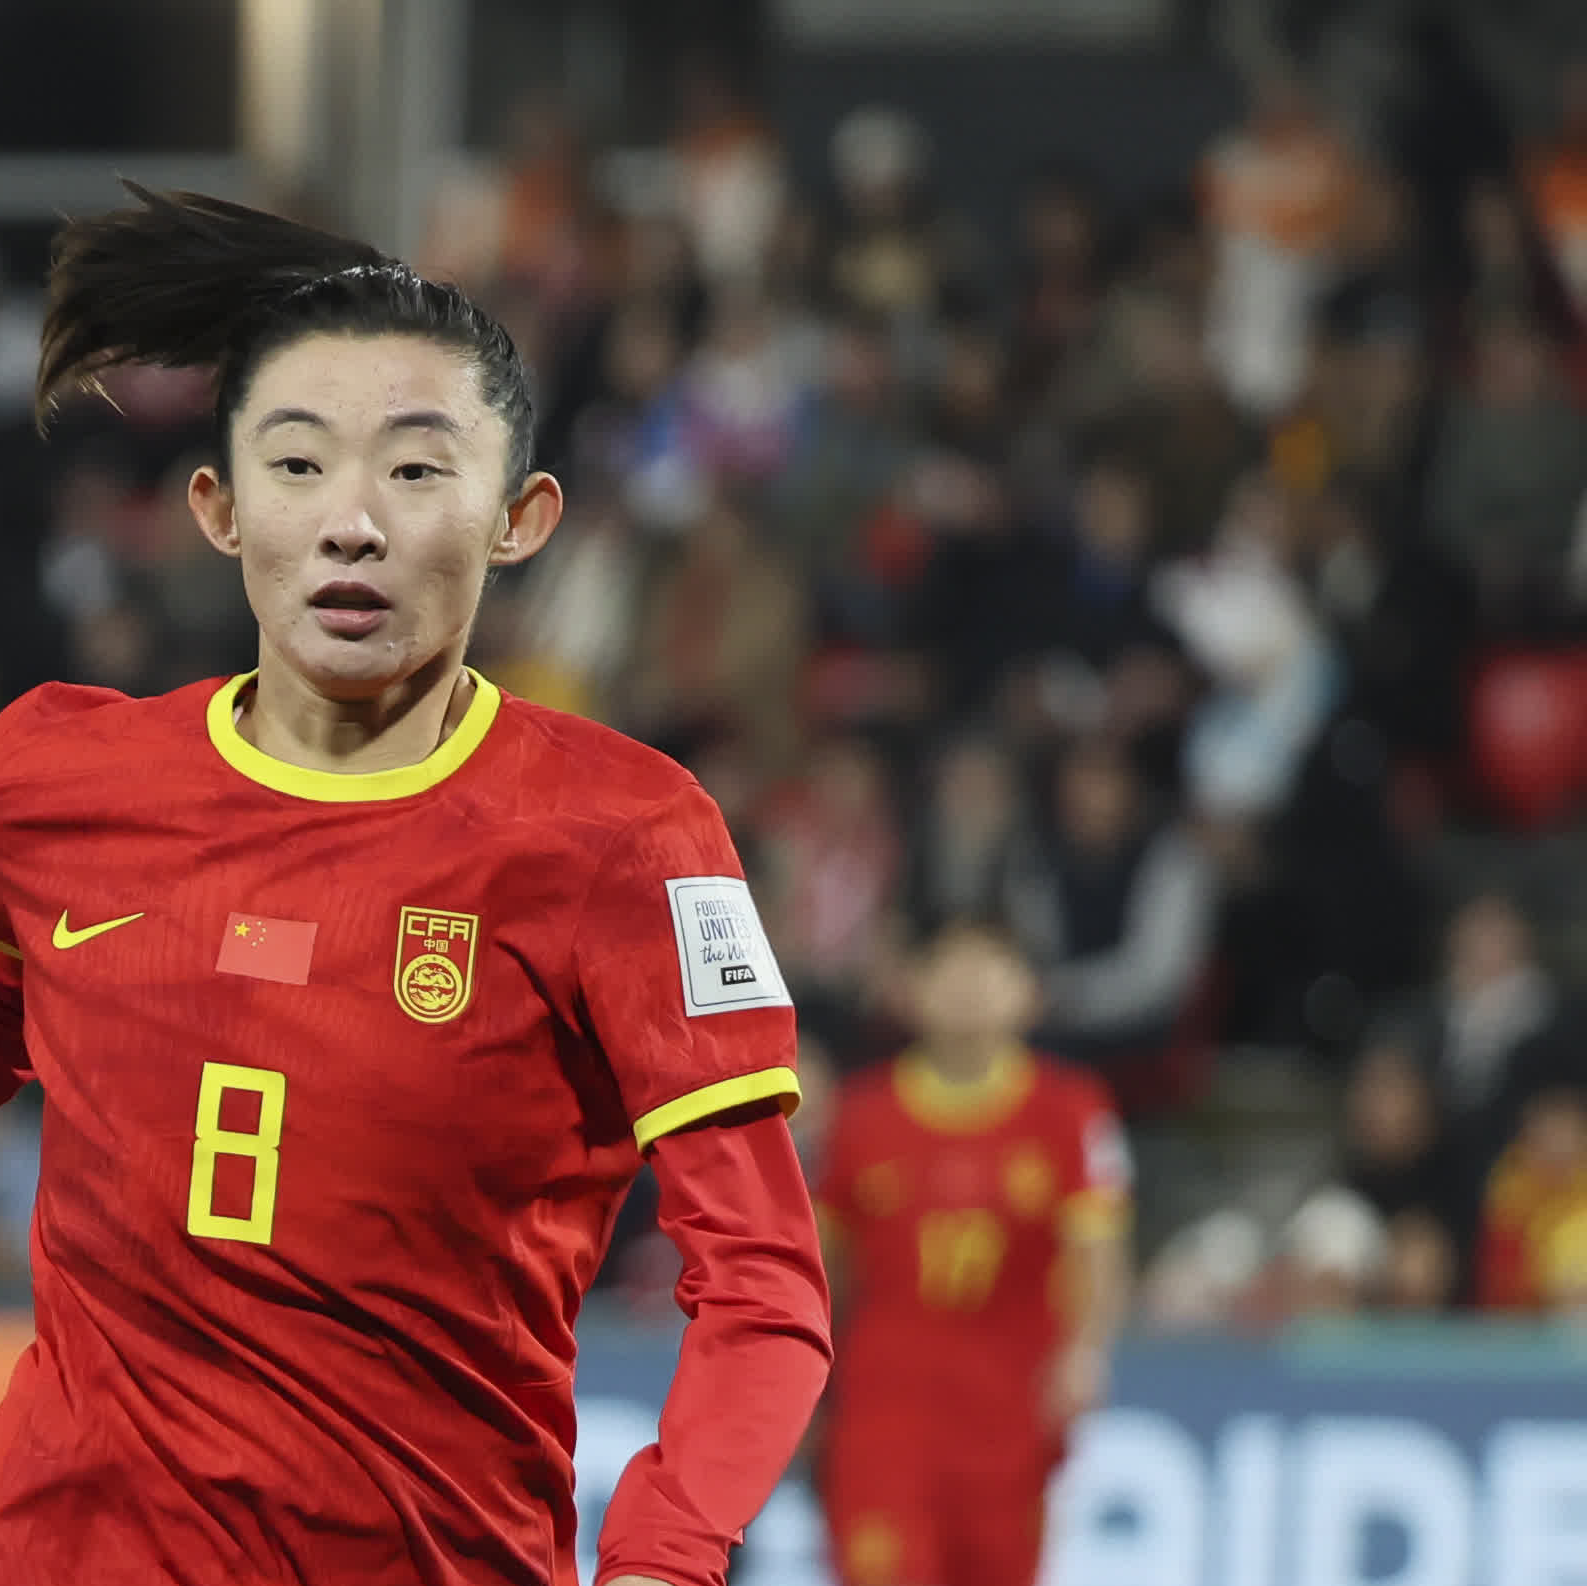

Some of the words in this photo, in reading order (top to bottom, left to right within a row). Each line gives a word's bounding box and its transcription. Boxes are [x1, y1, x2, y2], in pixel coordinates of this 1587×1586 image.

[406, 915, 470, 941] CFA
[699, 943, 725, 964] the
[725, 968, 754, 982] FIFA
[187, 1061, 287, 1245] 8
